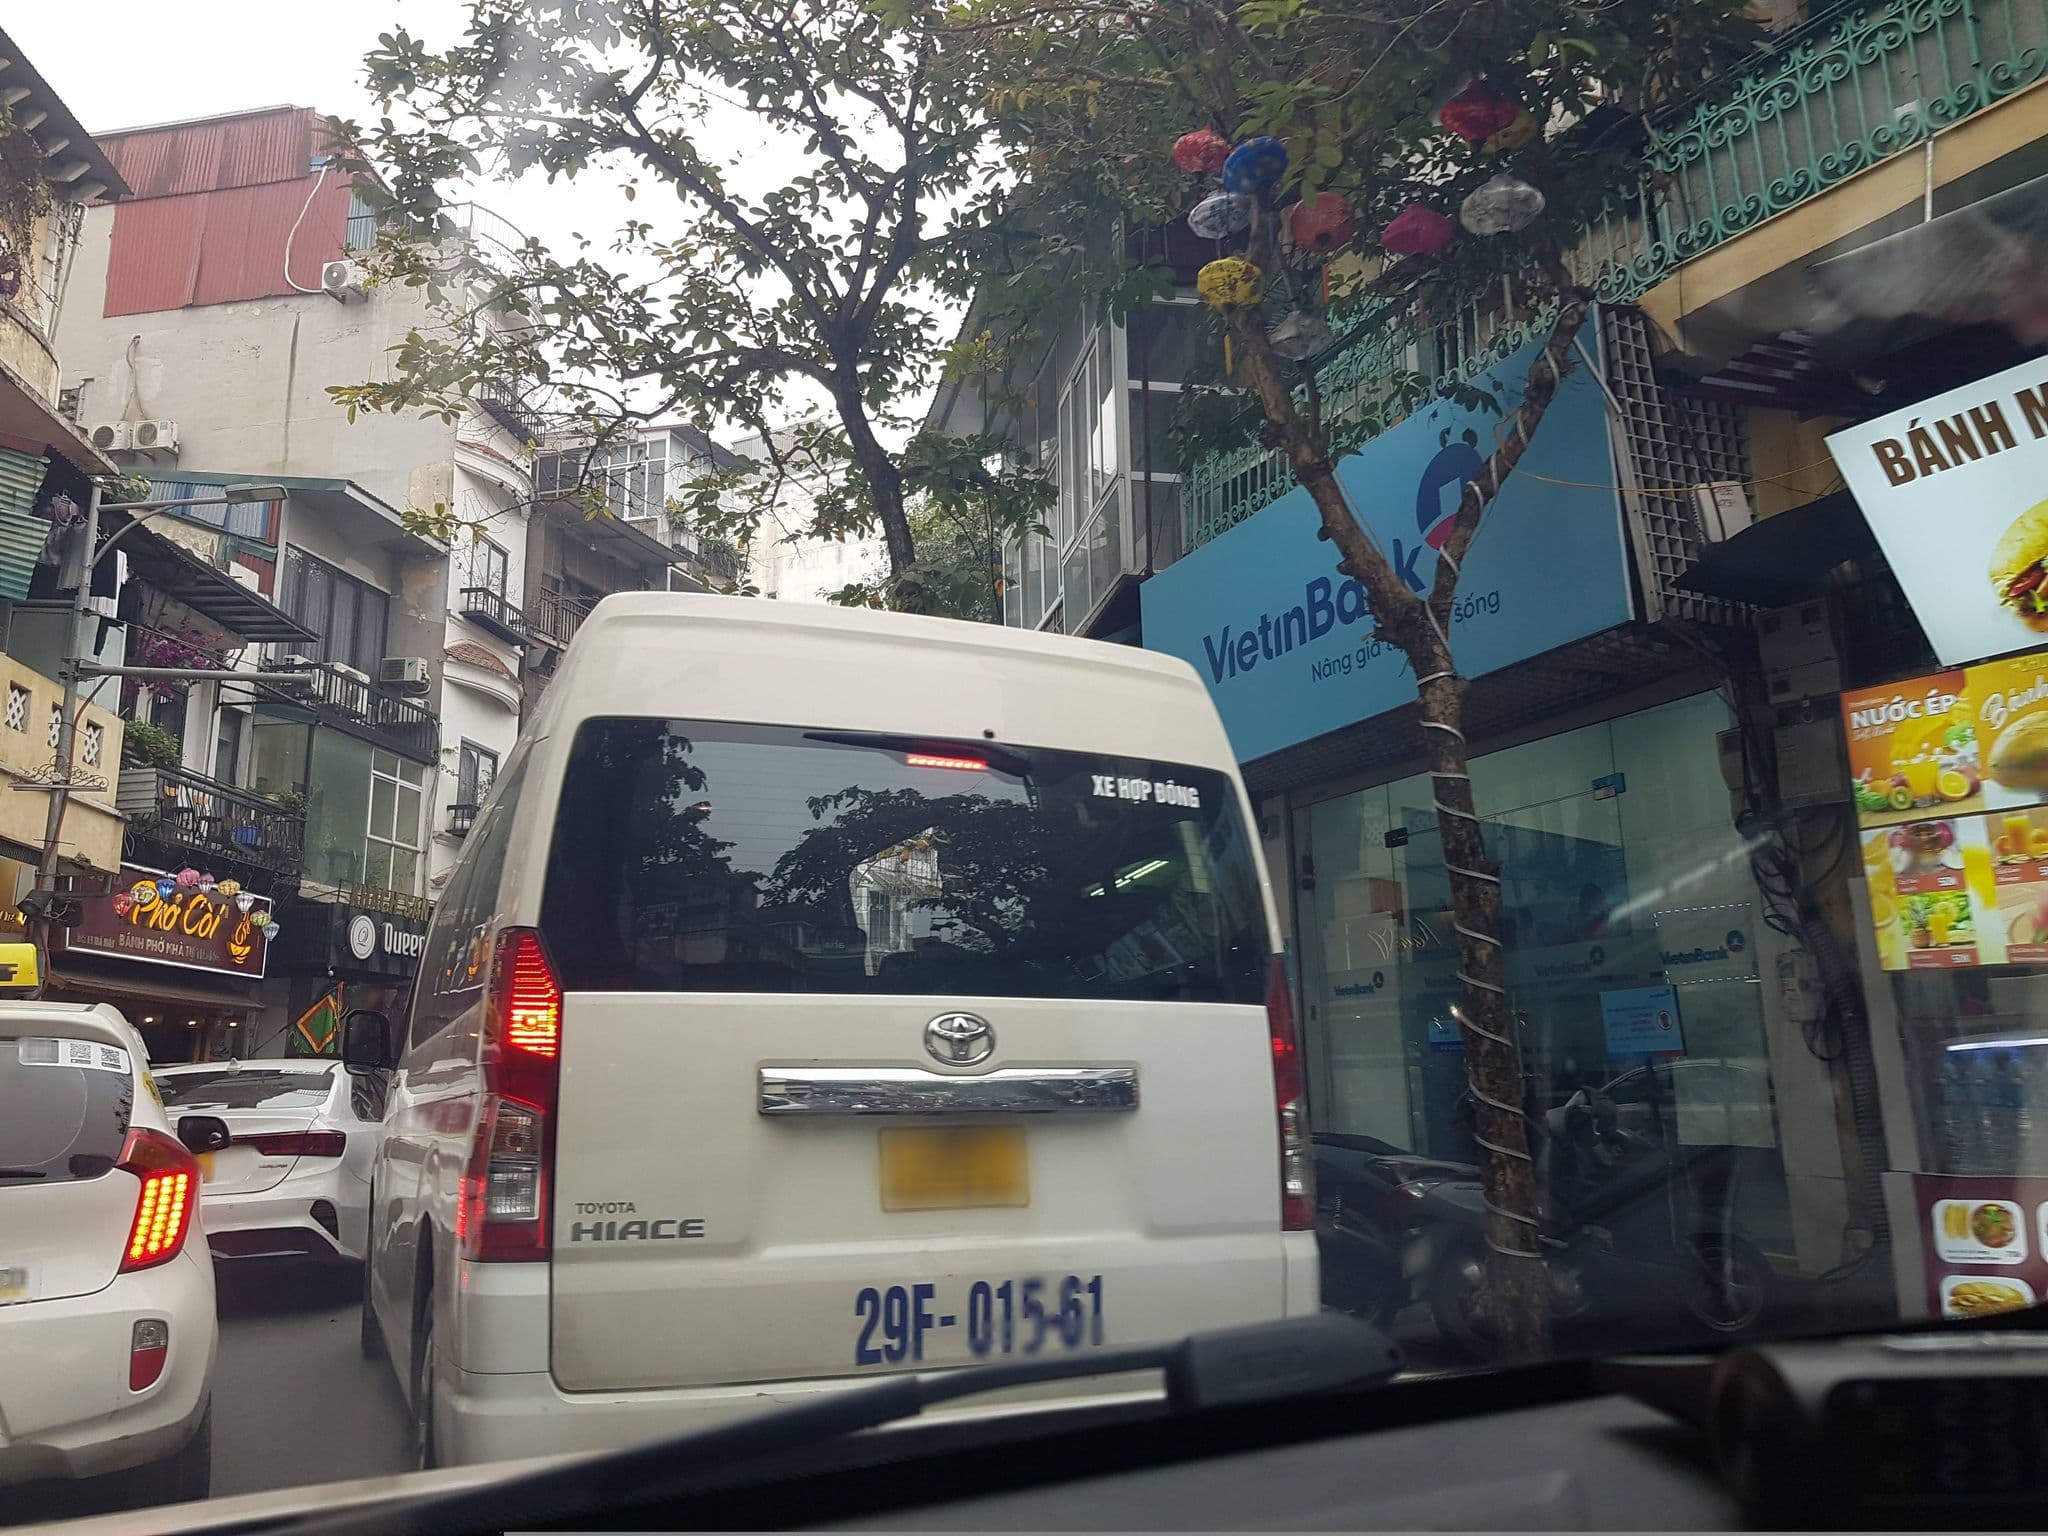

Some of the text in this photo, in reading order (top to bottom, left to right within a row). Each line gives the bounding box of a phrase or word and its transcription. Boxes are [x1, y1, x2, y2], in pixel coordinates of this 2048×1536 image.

[1871, 401, 2018, 487] BÁNH
[1202, 539, 1427, 685] VietinBak
[1311, 653, 1352, 684] Nâng
[1453, 590, 1500, 624] sống
[1091, 775, 1117, 798] XE
[118, 931, 145, 950] BÁNH
[145, 936, 165, 954] PHỞ
[165, 941, 185, 957] NHÀ
[575, 1202, 637, 1214] TOYOTA
[571, 1219, 705, 1241] HIACE
